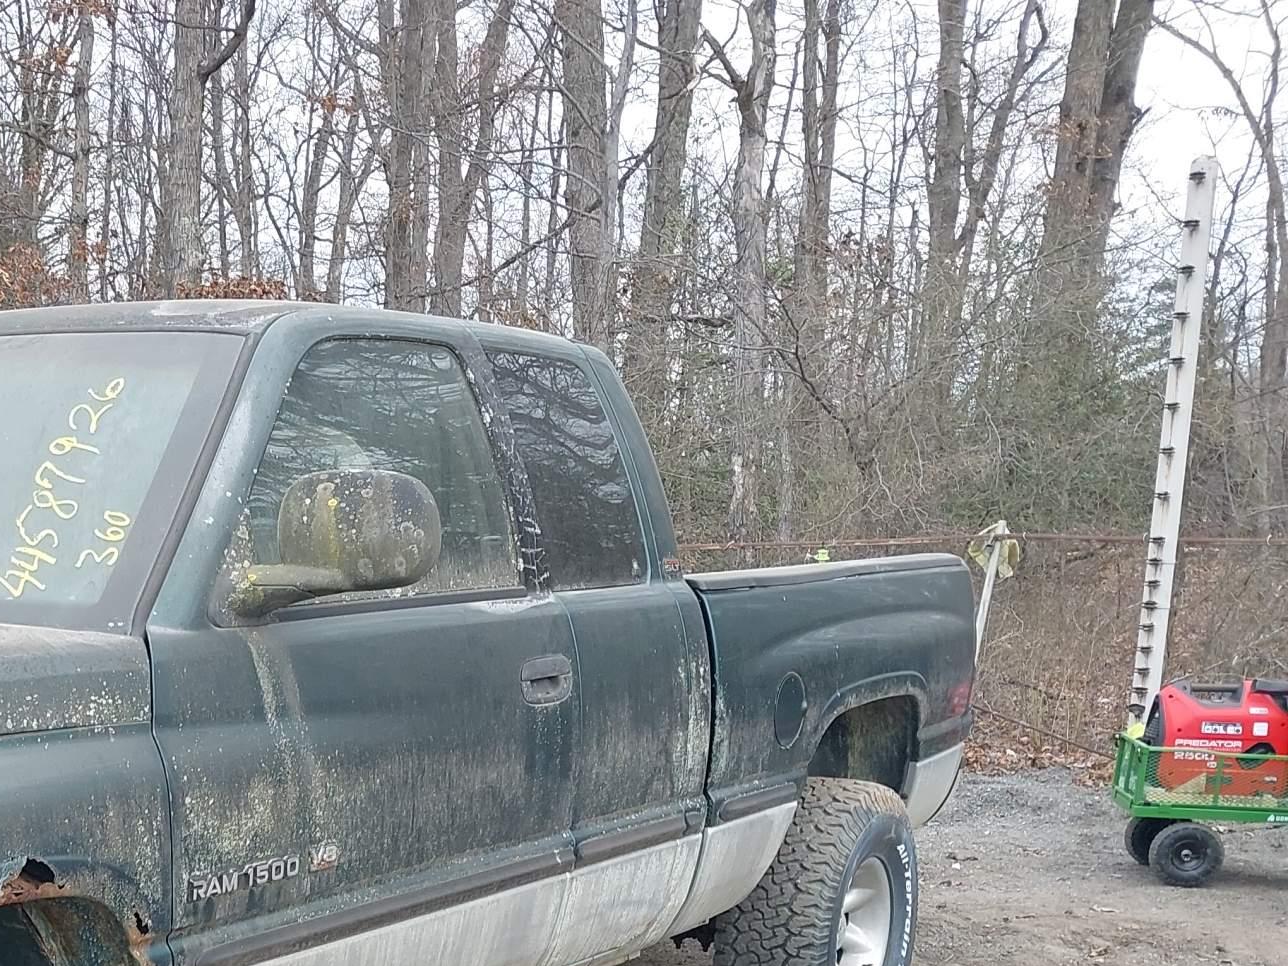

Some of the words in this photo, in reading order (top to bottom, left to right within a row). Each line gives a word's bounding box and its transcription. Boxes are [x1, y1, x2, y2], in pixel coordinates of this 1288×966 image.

[74, 510, 131, 568] 360
[1174, 738, 1243, 748] PREDATOR
[192, 871, 239, 901] RAM
[247, 855, 300, 887] 1500
[896, 843, 913, 959] All-Terrain
